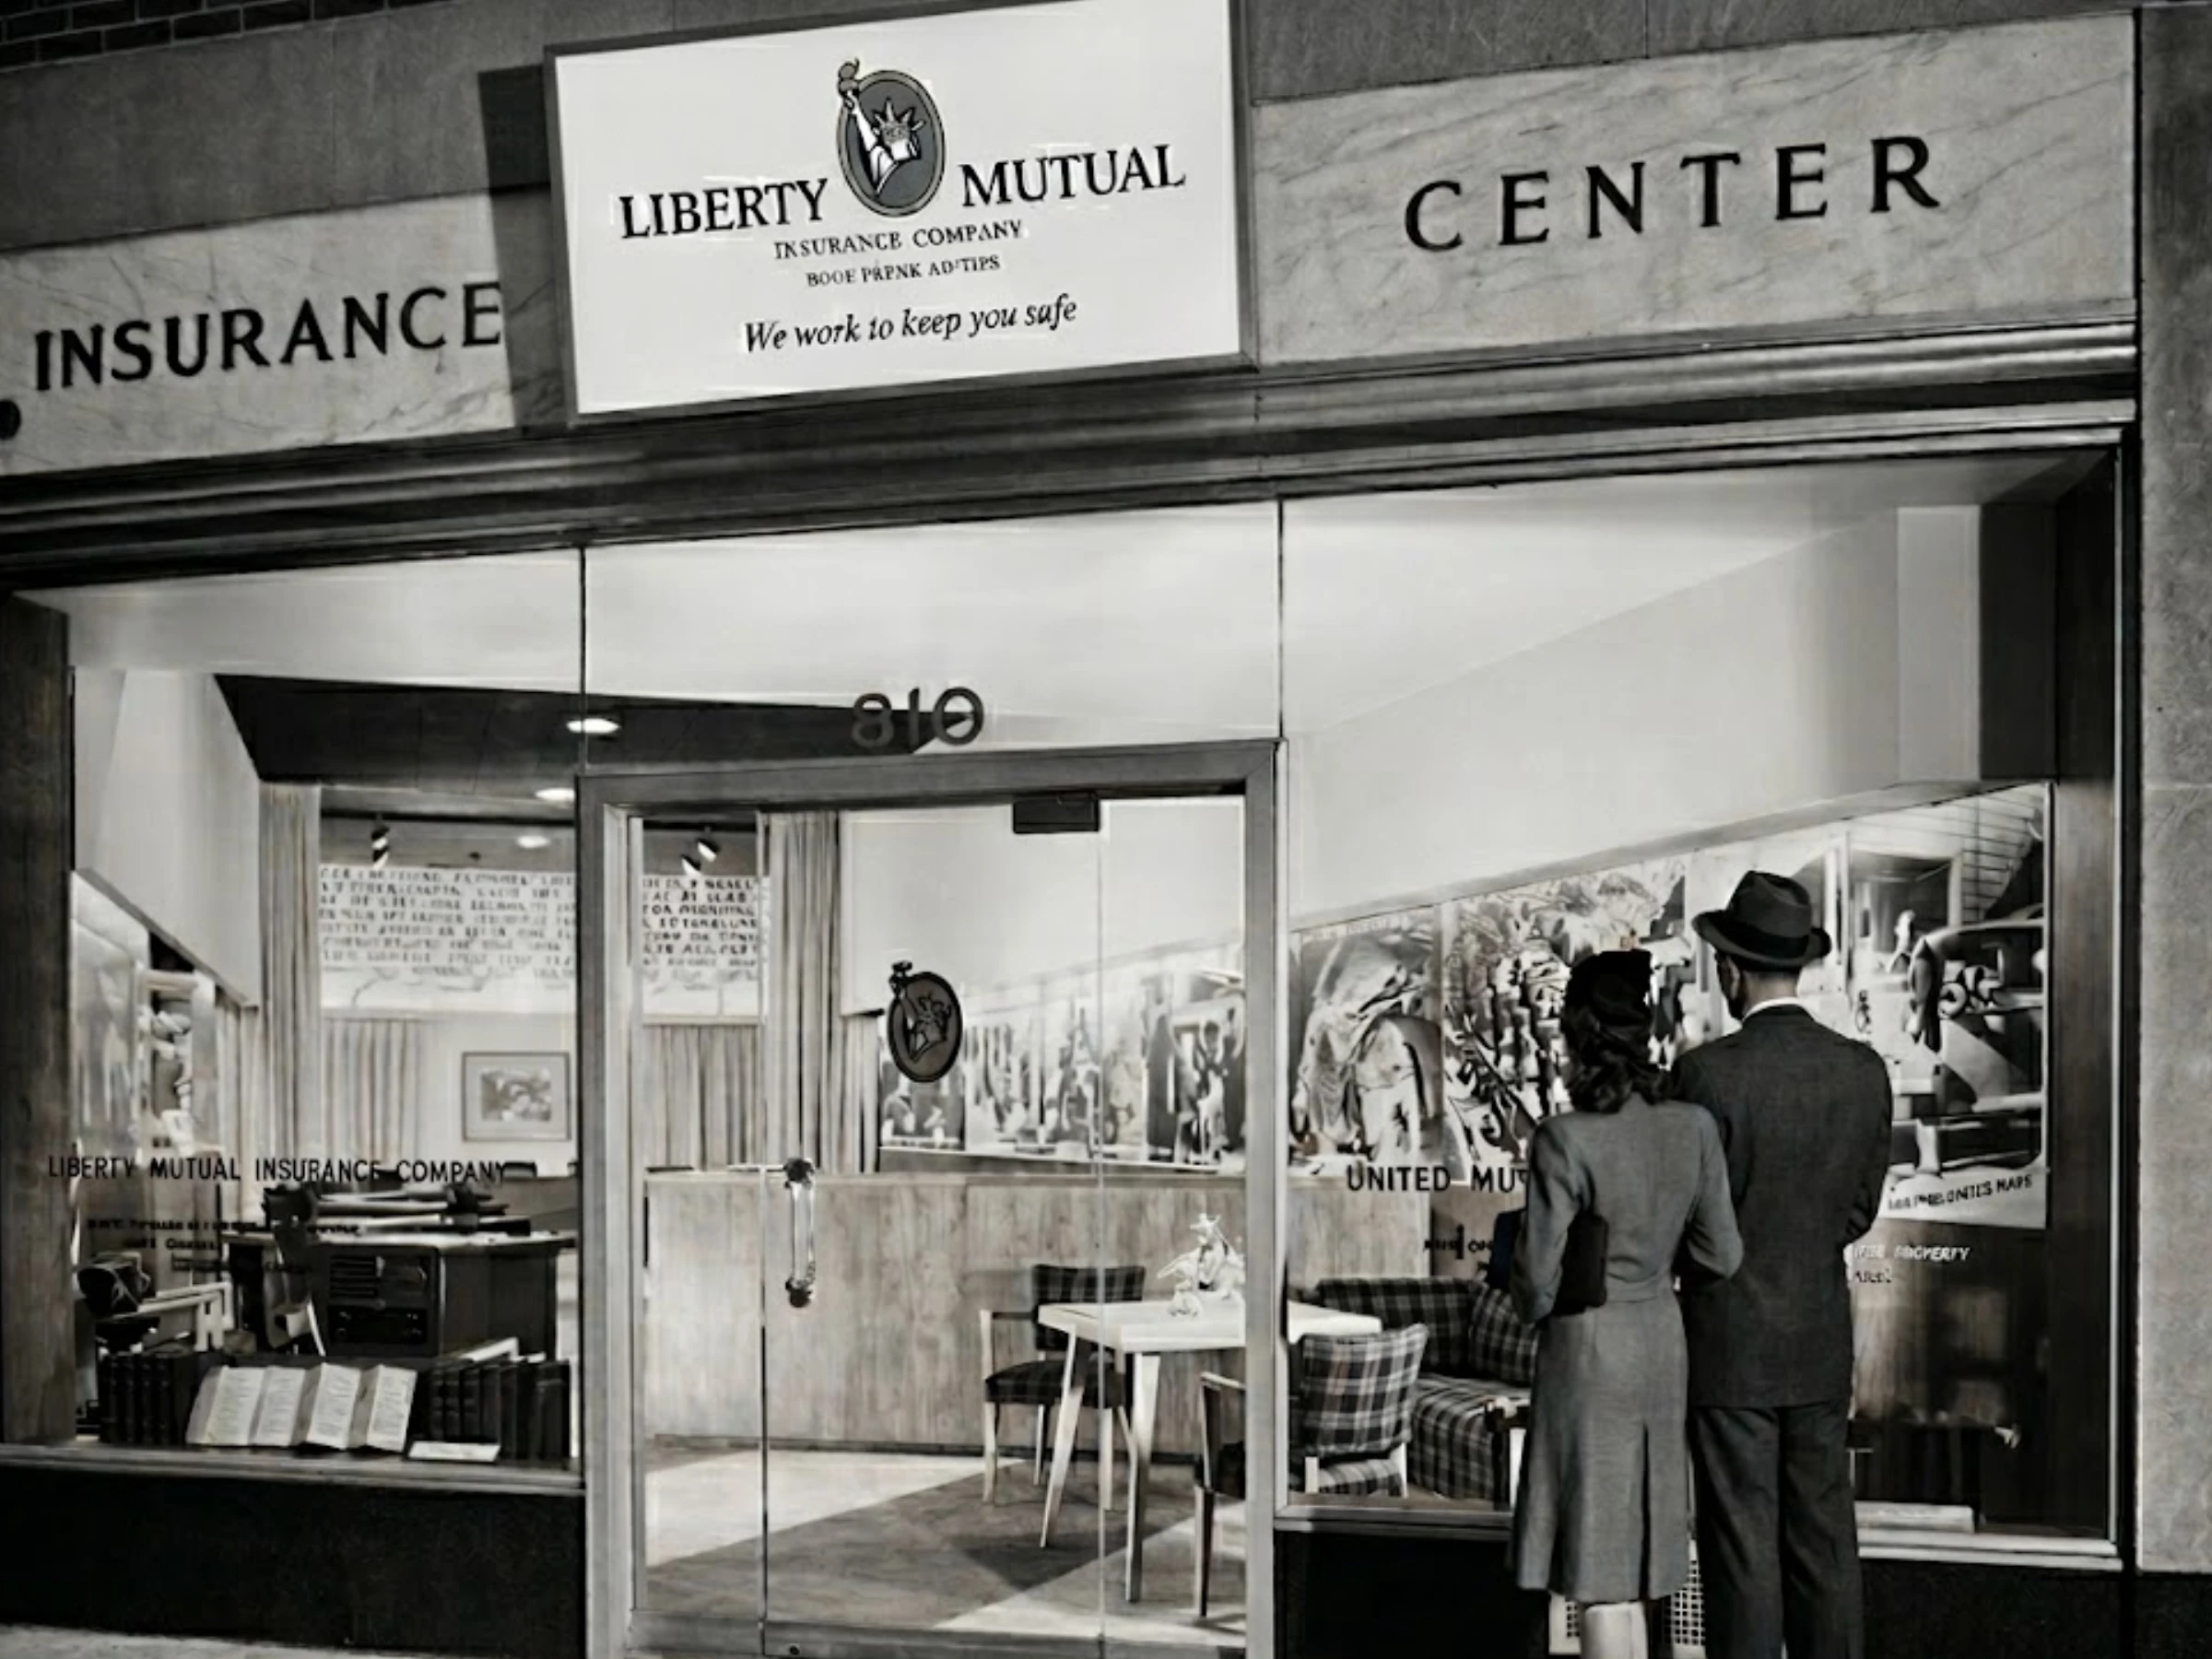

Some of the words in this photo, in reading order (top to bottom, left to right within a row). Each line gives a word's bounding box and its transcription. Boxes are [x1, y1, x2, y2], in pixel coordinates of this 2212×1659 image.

[619, 178, 827, 239] LIBERTY
[960, 144, 1186, 207] MUTUAL
[1405, 135, 1940, 252] CENTER
[773, 231, 902, 260] INSURANCE
[912, 219, 1021, 248] COMPANY
[34, 281, 500, 393] INSURANCE
[746, 322, 787, 353] We
[794, 313, 861, 346] work
[868, 318, 895, 341] to
[901, 308, 962, 341] keep
[968, 307, 1018, 338] you
[1024, 293, 1077, 332] safe
[852, 687, 983, 753] 810
[49, 1157, 135, 1180] LIBERTY
[150, 1157, 241, 1181] MUTUAL
[397, 1159, 507, 1183] COMPANY
[1347, 1165, 1452, 1192] UNITED
